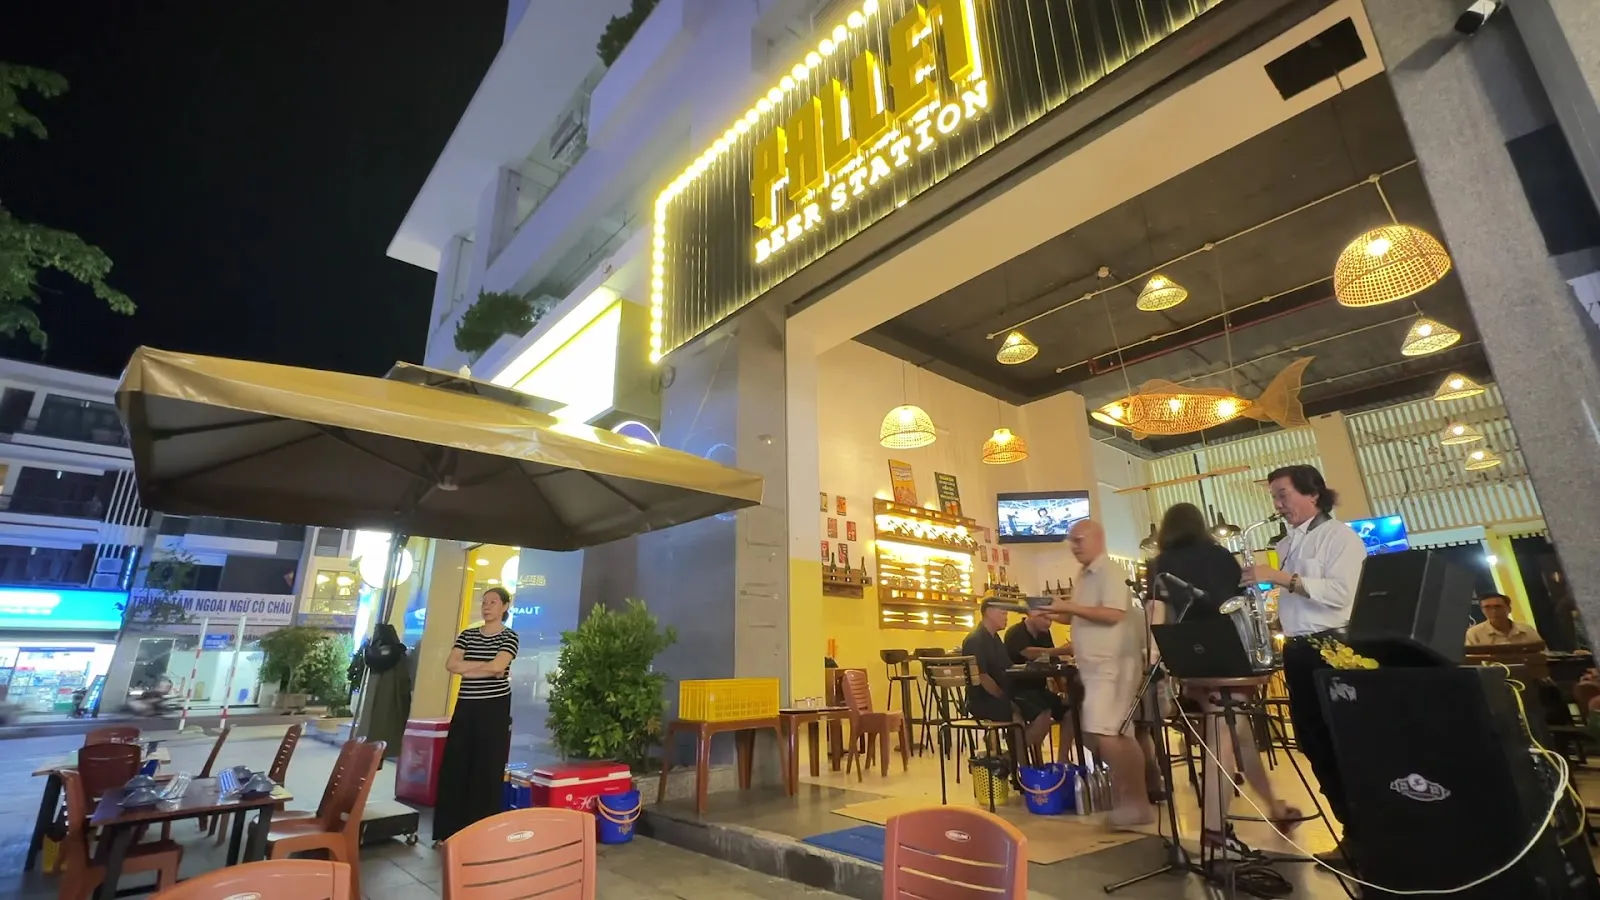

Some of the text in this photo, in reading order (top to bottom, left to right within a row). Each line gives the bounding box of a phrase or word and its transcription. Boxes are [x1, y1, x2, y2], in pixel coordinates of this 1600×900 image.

[755, 80, 988, 263] BEER STATION
[195, 598, 227, 615] NGOẠI
